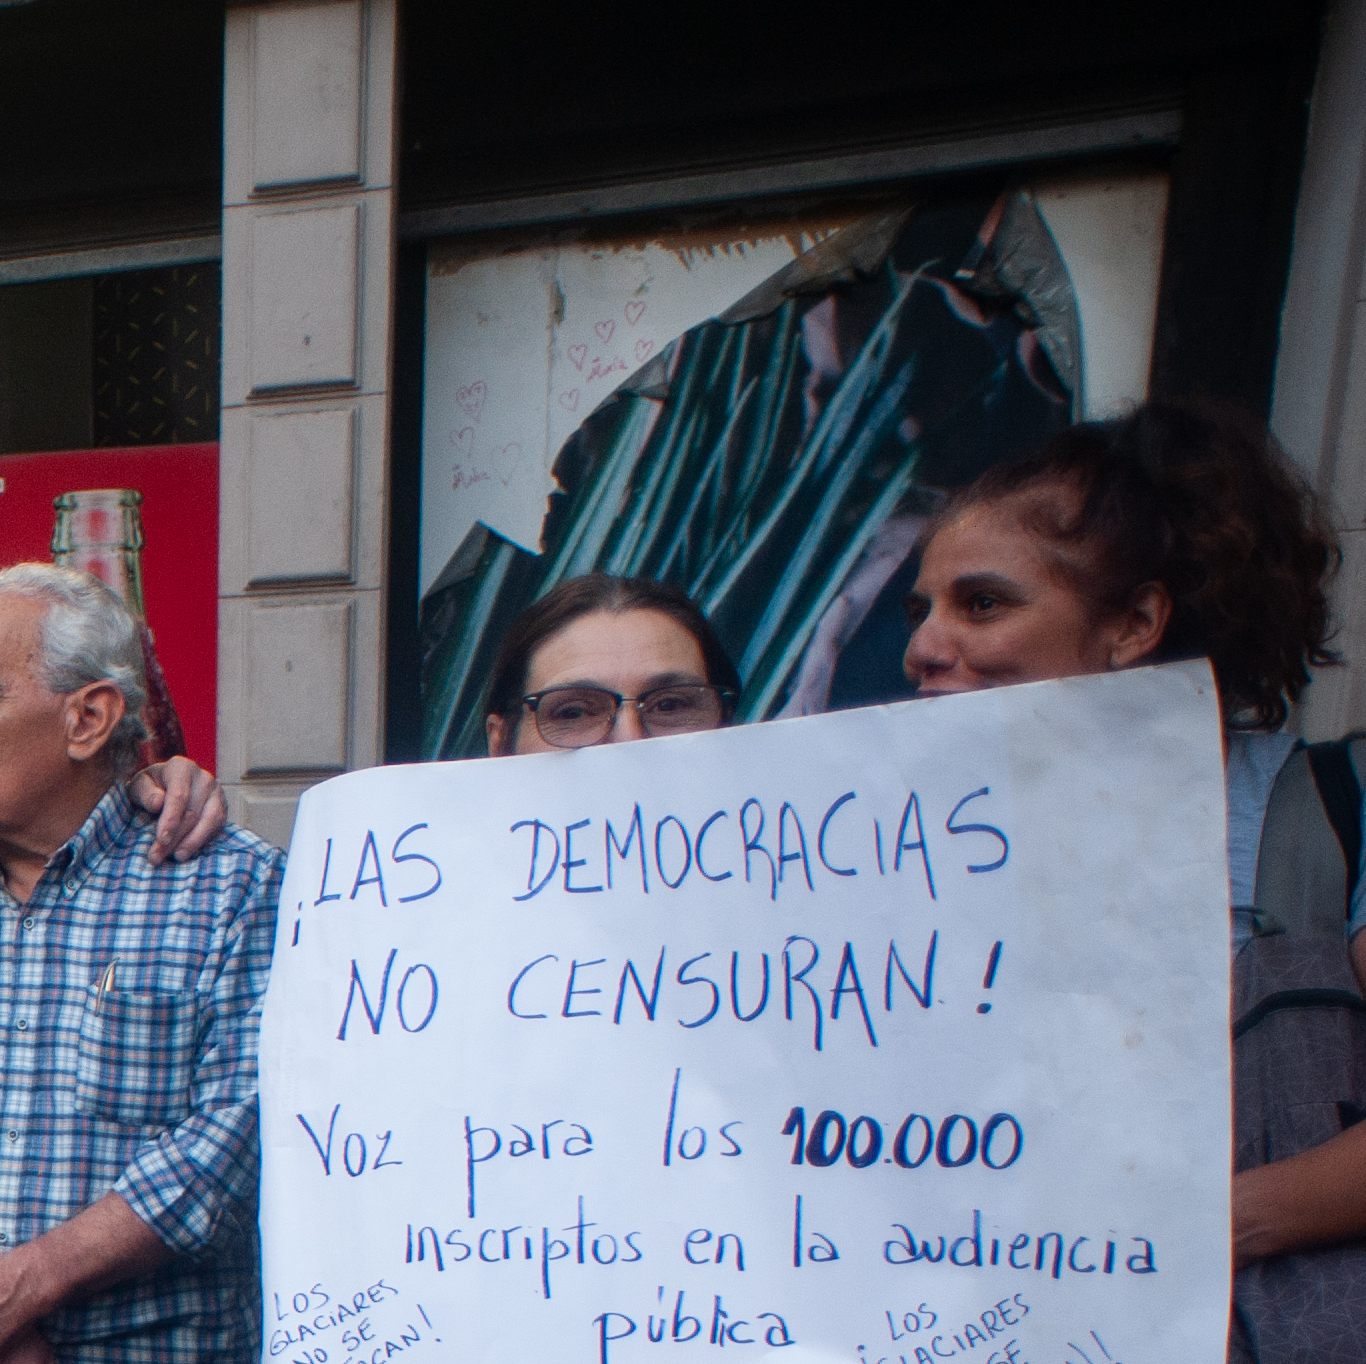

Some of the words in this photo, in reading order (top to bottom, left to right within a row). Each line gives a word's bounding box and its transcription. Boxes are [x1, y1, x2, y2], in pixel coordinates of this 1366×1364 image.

[509, 786, 1009, 901] DEMOCRACIAS
[336, 948, 439, 1041] NO
[296, 1103, 403, 1177] Voz
[464, 1115, 595, 1218] para
[663, 1067, 743, 1167] los
[781, 1106, 1024, 1170] 100.000
[684, 1228, 745, 1271] en
[791, 1194, 840, 1268] la
[883, 1209, 1159, 1280] audiencia
[273, 1283, 330, 1322] LOS
[341, 1317, 376, 1352] SE
[885, 1302, 938, 1341] LOS
